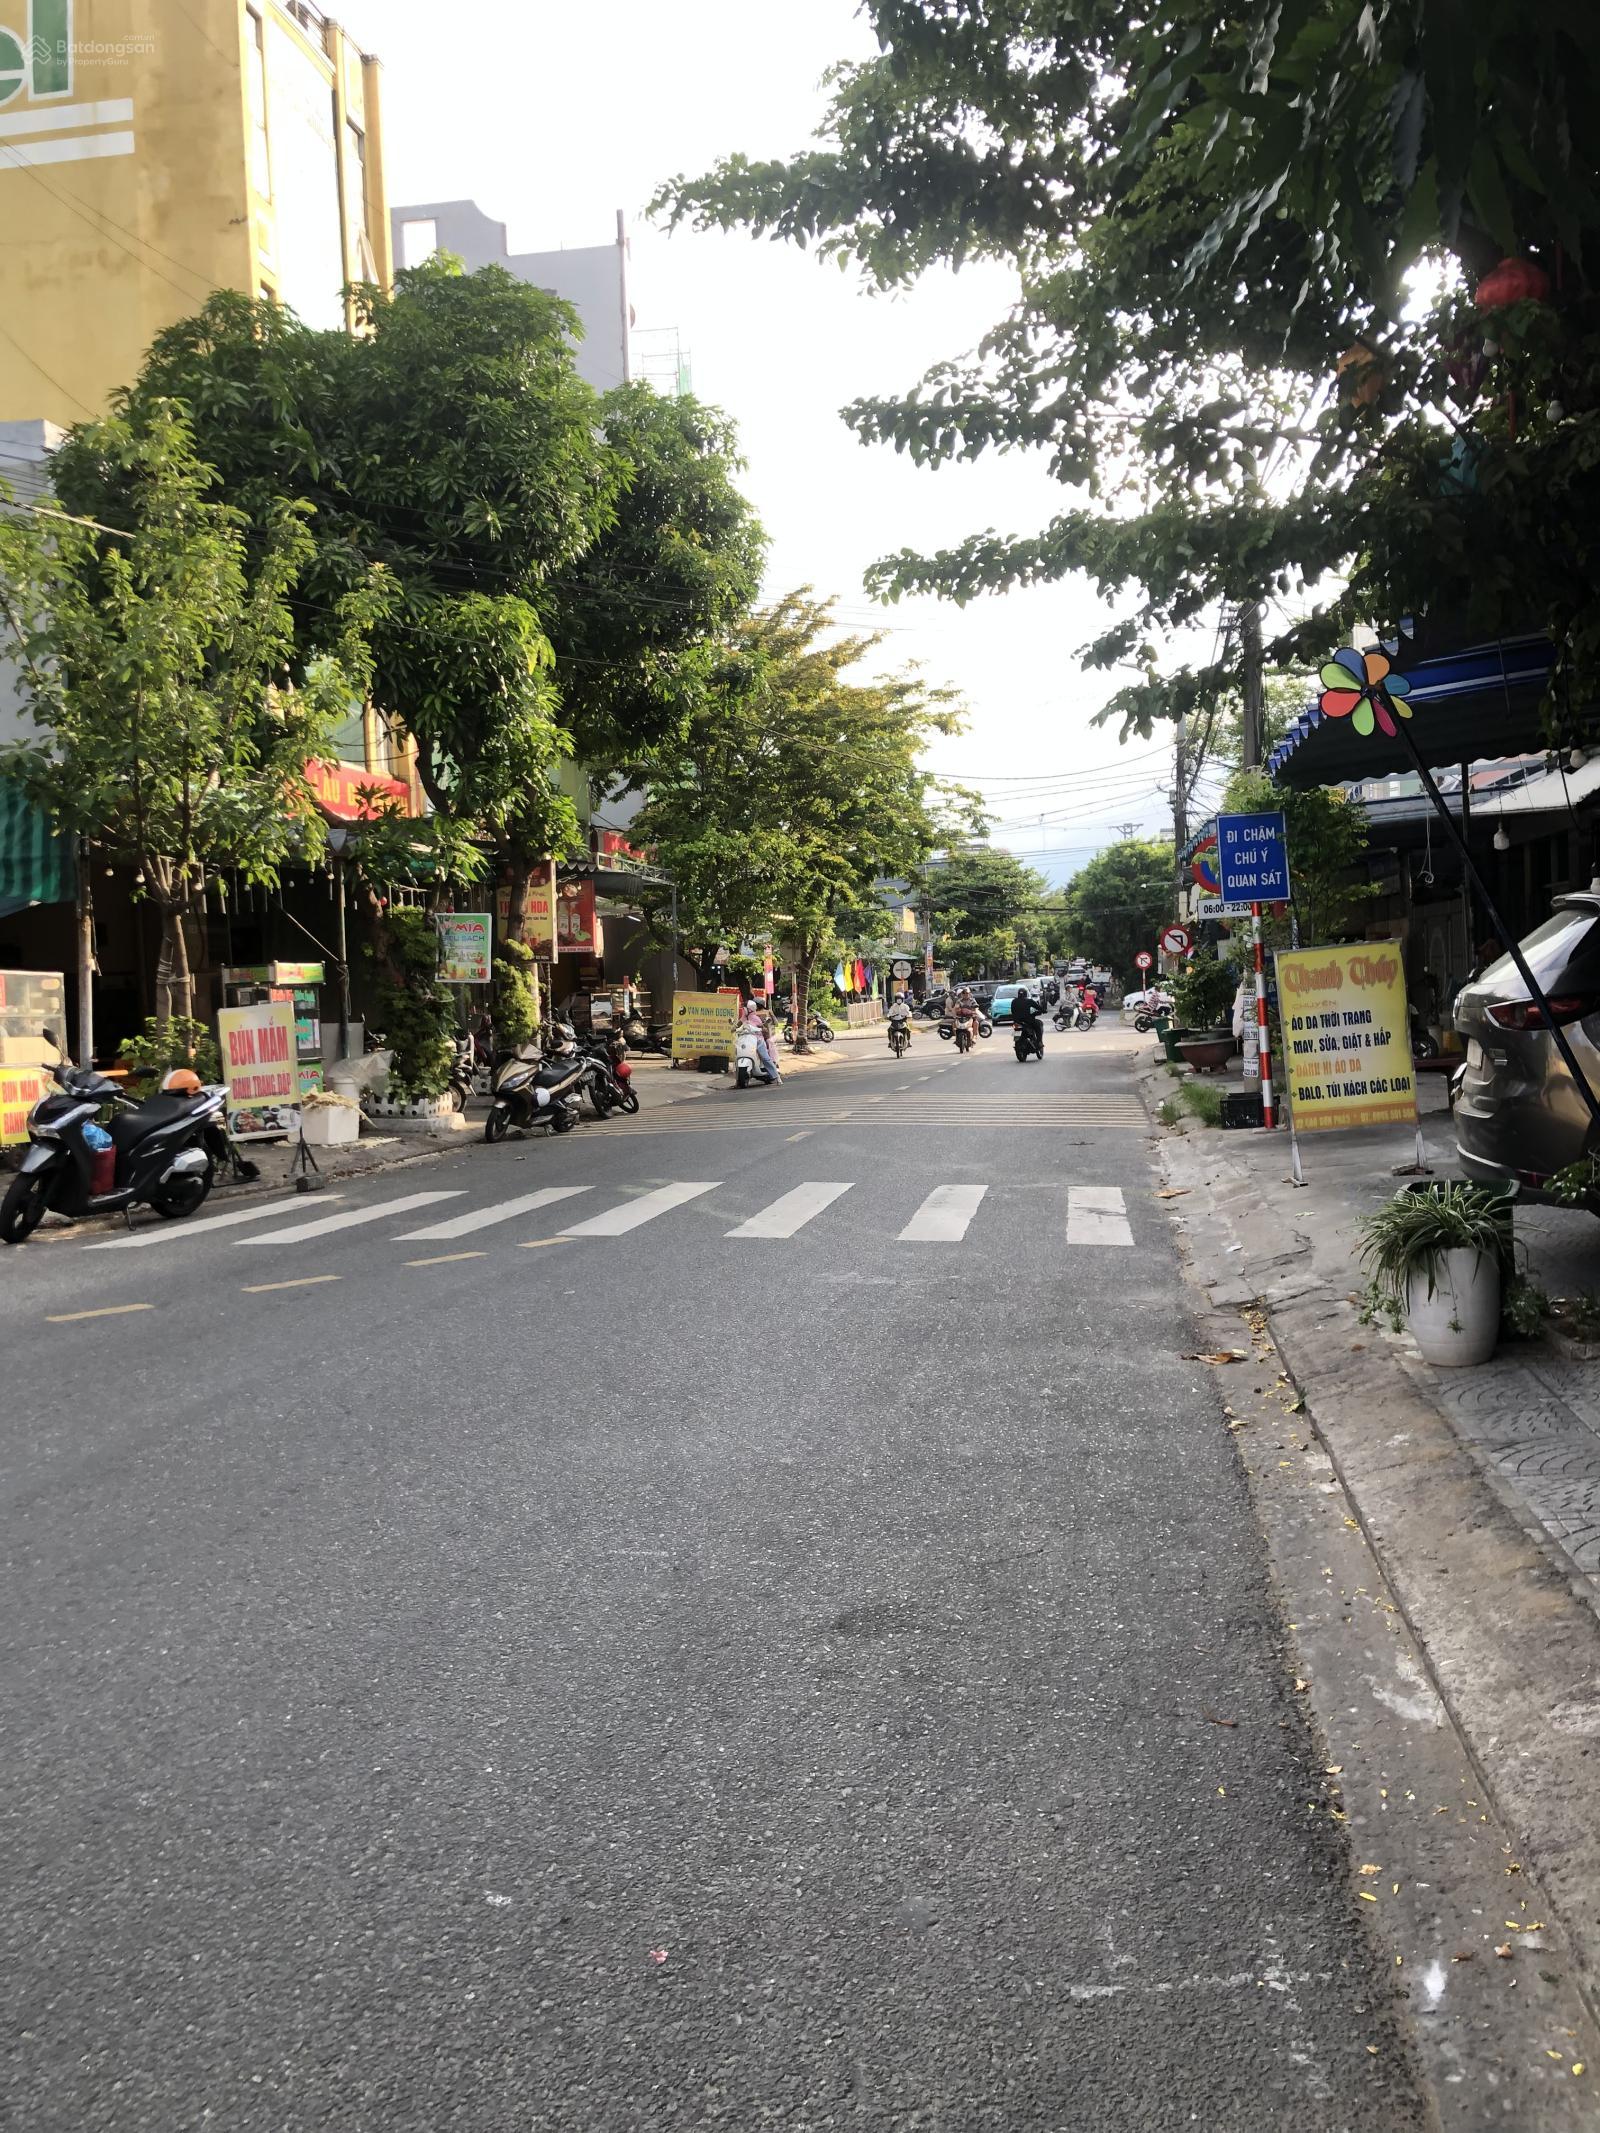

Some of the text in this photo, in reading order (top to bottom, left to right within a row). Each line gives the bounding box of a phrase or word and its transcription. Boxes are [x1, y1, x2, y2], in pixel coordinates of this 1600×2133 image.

[1226, 826, 1276, 843] ĐI CHẬM
[1234, 847, 1269, 865] CHÚ Ý
[1227, 869, 1282, 888] QUAN SÁT
[1203, 904, 1225, 914] 06:00
[1306, 1015, 1318, 1030] DA
[1320, 1010, 1340, 1028] THỜI
[1342, 1010, 1372, 1025] TRANG
[1293, 1039, 1317, 1054] MAY,
[1365, 1033, 1372, 1047] &
[1298, 1076, 1411, 1101] BALO, TÚI XÁCH CÁC LOẠI
